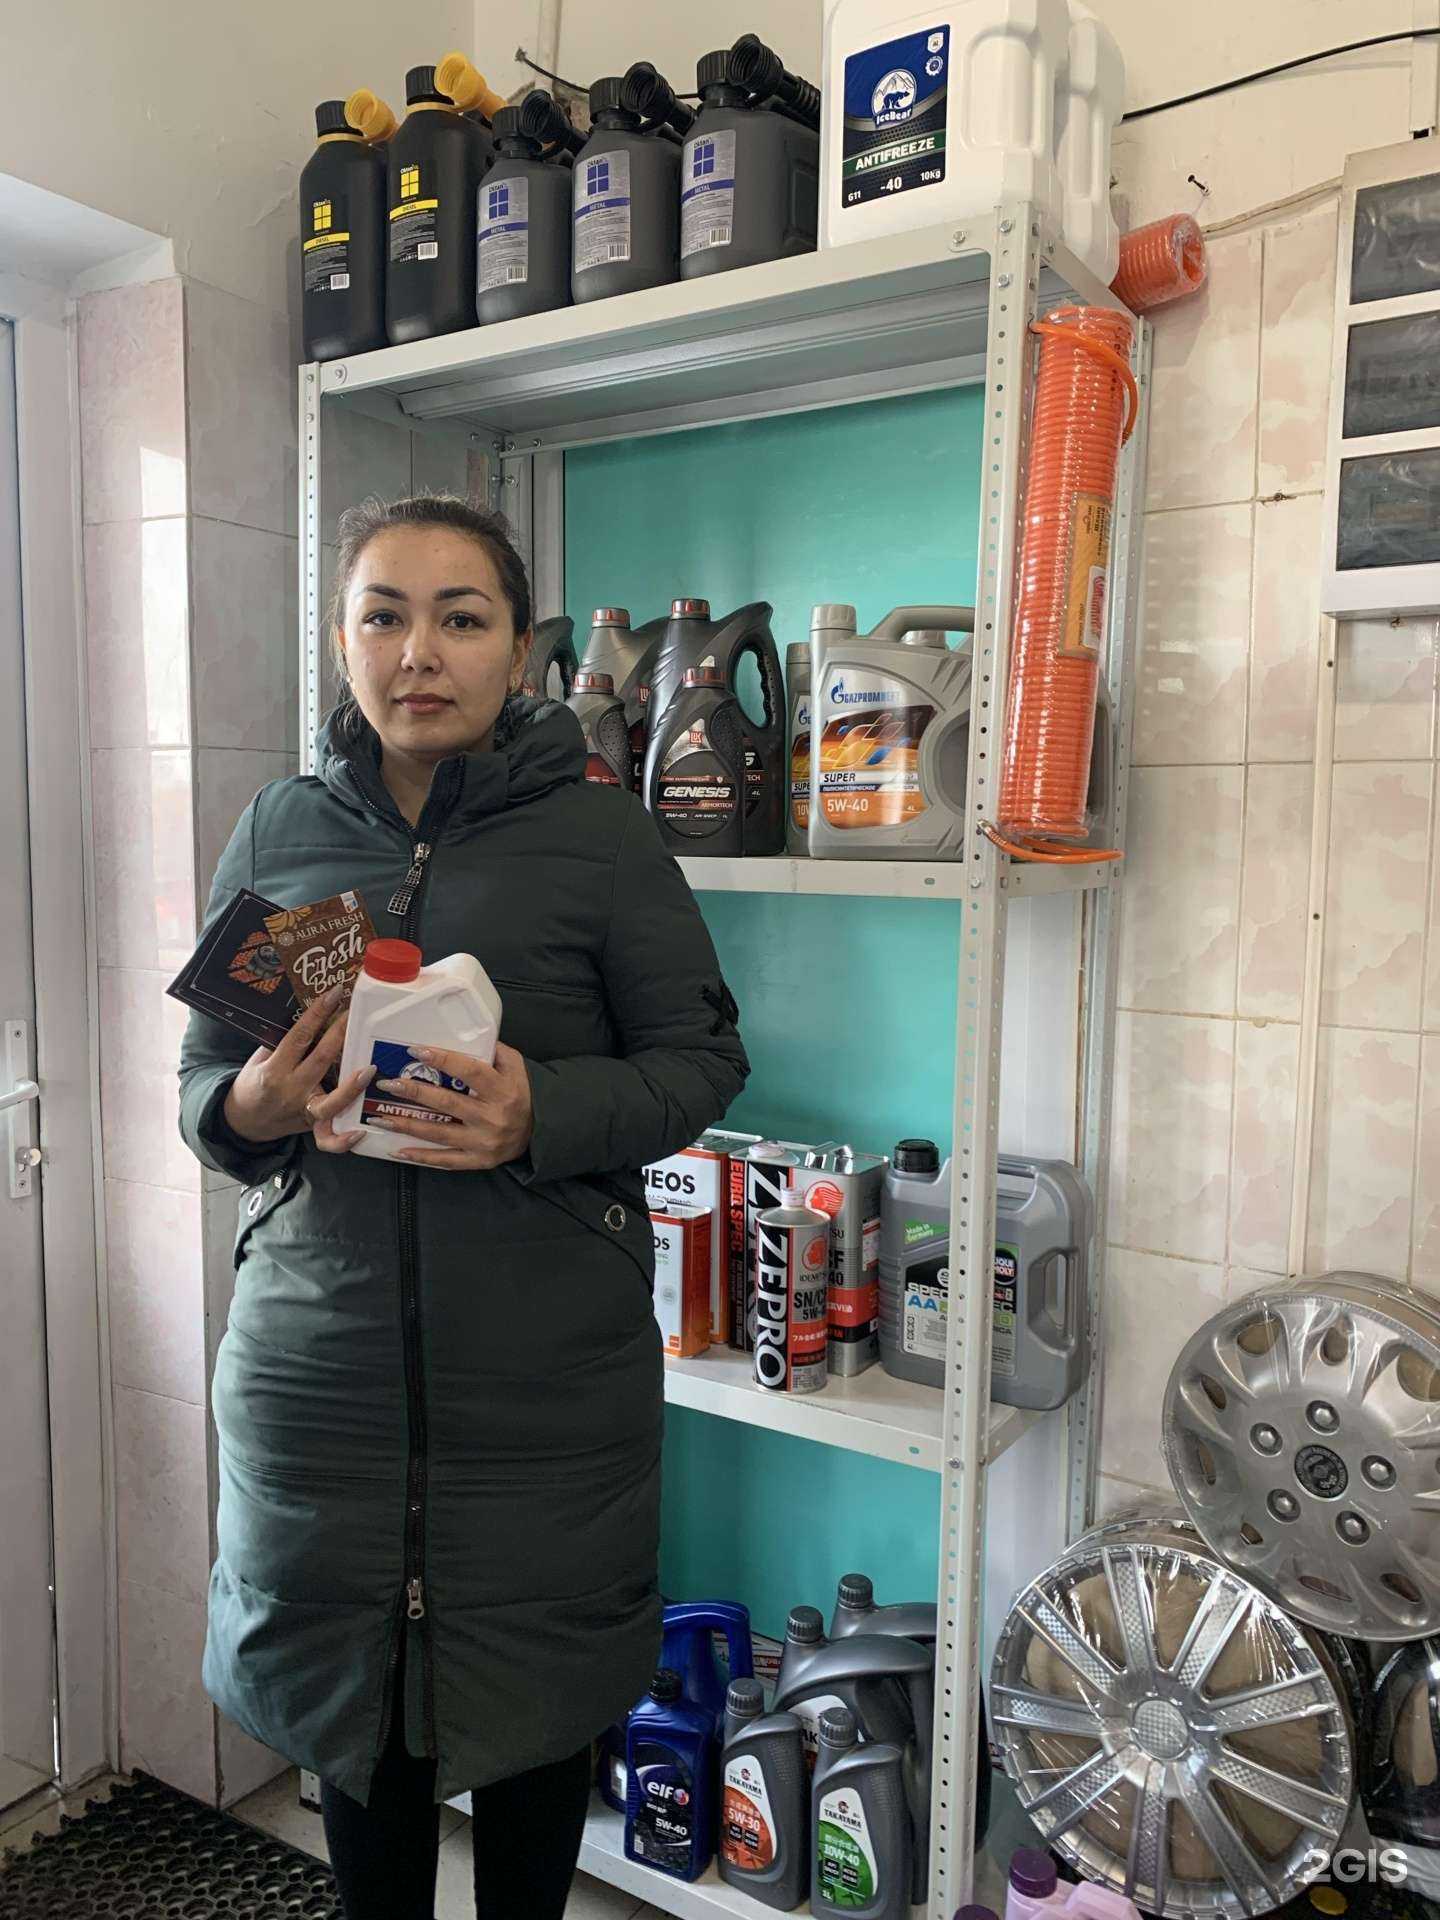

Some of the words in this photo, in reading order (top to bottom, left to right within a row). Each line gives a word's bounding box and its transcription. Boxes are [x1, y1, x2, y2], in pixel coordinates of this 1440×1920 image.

[855, 137, 935, 171] ANTIFREEZE
[880, 176, 902, 192] -40
[793, 782, 810, 791] SUPE
[823, 772, 856, 783] SUPER
[663, 786, 731, 798] GENESIS
[827, 798, 869, 812] 5W-40
[328, 911, 365, 930] FRESH
[293, 923, 366, 986] Fresh
[309, 969, 356, 994] Bag
[644, 1168, 696, 1195] NEOS
[730, 1161, 744, 1207] EURO
[730, 1209, 744, 1252] SPEC
[908, 1282, 949, 1299] SPEC
[757, 1224, 788, 1387] ZEPRO
[647, 1781, 675, 1799] elf
[729, 1774, 763, 1795] TAKAYAMA
[655, 1817, 688, 1836] 5W-40
[728, 1807, 760, 1832] 5W-30
[824, 1807, 862, 1829] TAKAYAMA
[824, 1843, 860, 1867] 10W-40
